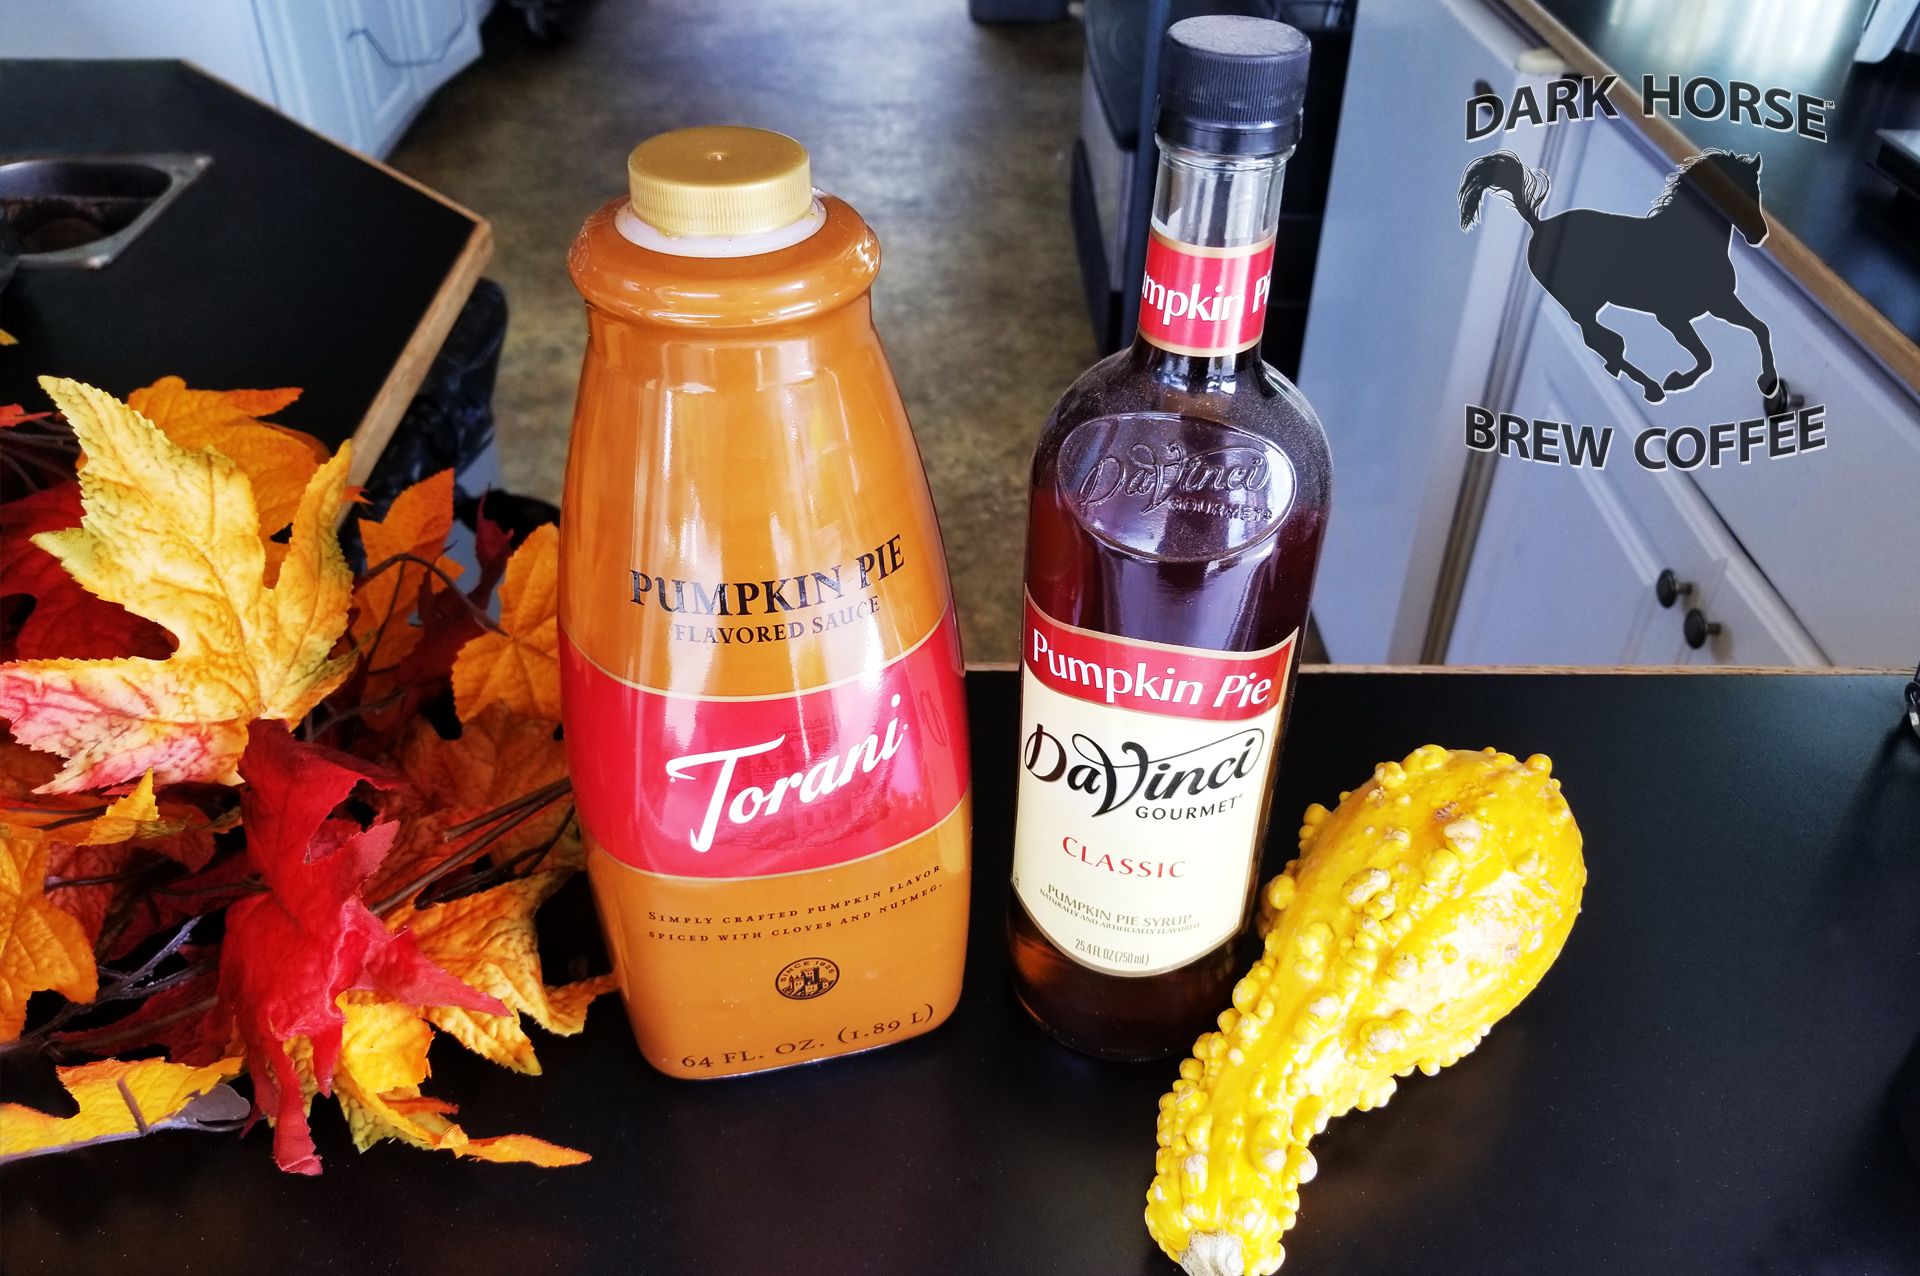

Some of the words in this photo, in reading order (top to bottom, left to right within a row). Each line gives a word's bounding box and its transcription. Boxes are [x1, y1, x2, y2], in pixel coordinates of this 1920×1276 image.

[1079, 442, 1271, 515] DaVinci
[630, 564, 843, 616] PUMPKIN
[856, 534, 905, 590] PIE
[674, 620, 805, 644] FLAVORED
[812, 595, 881, 634] SAUCE
[1033, 628, 1204, 705] Pumpkin
[1212, 672, 1272, 708] Pie
[666, 694, 904, 853] Torani
[1024, 723, 1265, 818] DaVinci
[1135, 794, 1238, 821] GOURMET
[1062, 836, 1186, 878] CLASSIC
[649, 931, 709, 941] SPICED
[718, 932, 762, 941] WITH
[771, 920, 832, 936] CLOVES
[840, 911, 871, 925] AND
[879, 884, 942, 914] NUTMEG.
[722, 910, 798, 924] CRAFTED
[807, 891, 881, 914] PUMPKIN
[889, 865, 940, 893] FLAVOR
[1039, 888, 1079, 917] NATURALLY
[1080, 914, 1098, 925] AND
[1100, 921, 1156, 934] ARTIFICIALLY
[1157, 922, 1200, 935] FLAVORED
[1048, 884, 1112, 921] PUMPKIN
[1116, 913, 1138, 927] PIE
[1143, 914, 1193, 928] SYRUP
[780, 961, 810, 982] SINCE
[1075, 938, 1092, 955] 25.4
[1115, 951, 1134, 964] (750
[681, 1054, 714, 1068] 64
[722, 1050, 764, 1064] FL.
[775, 1038, 825, 1055] OZ.
[837, 1019, 901, 1044] (1.89
[910, 1002, 934, 1025] L)
